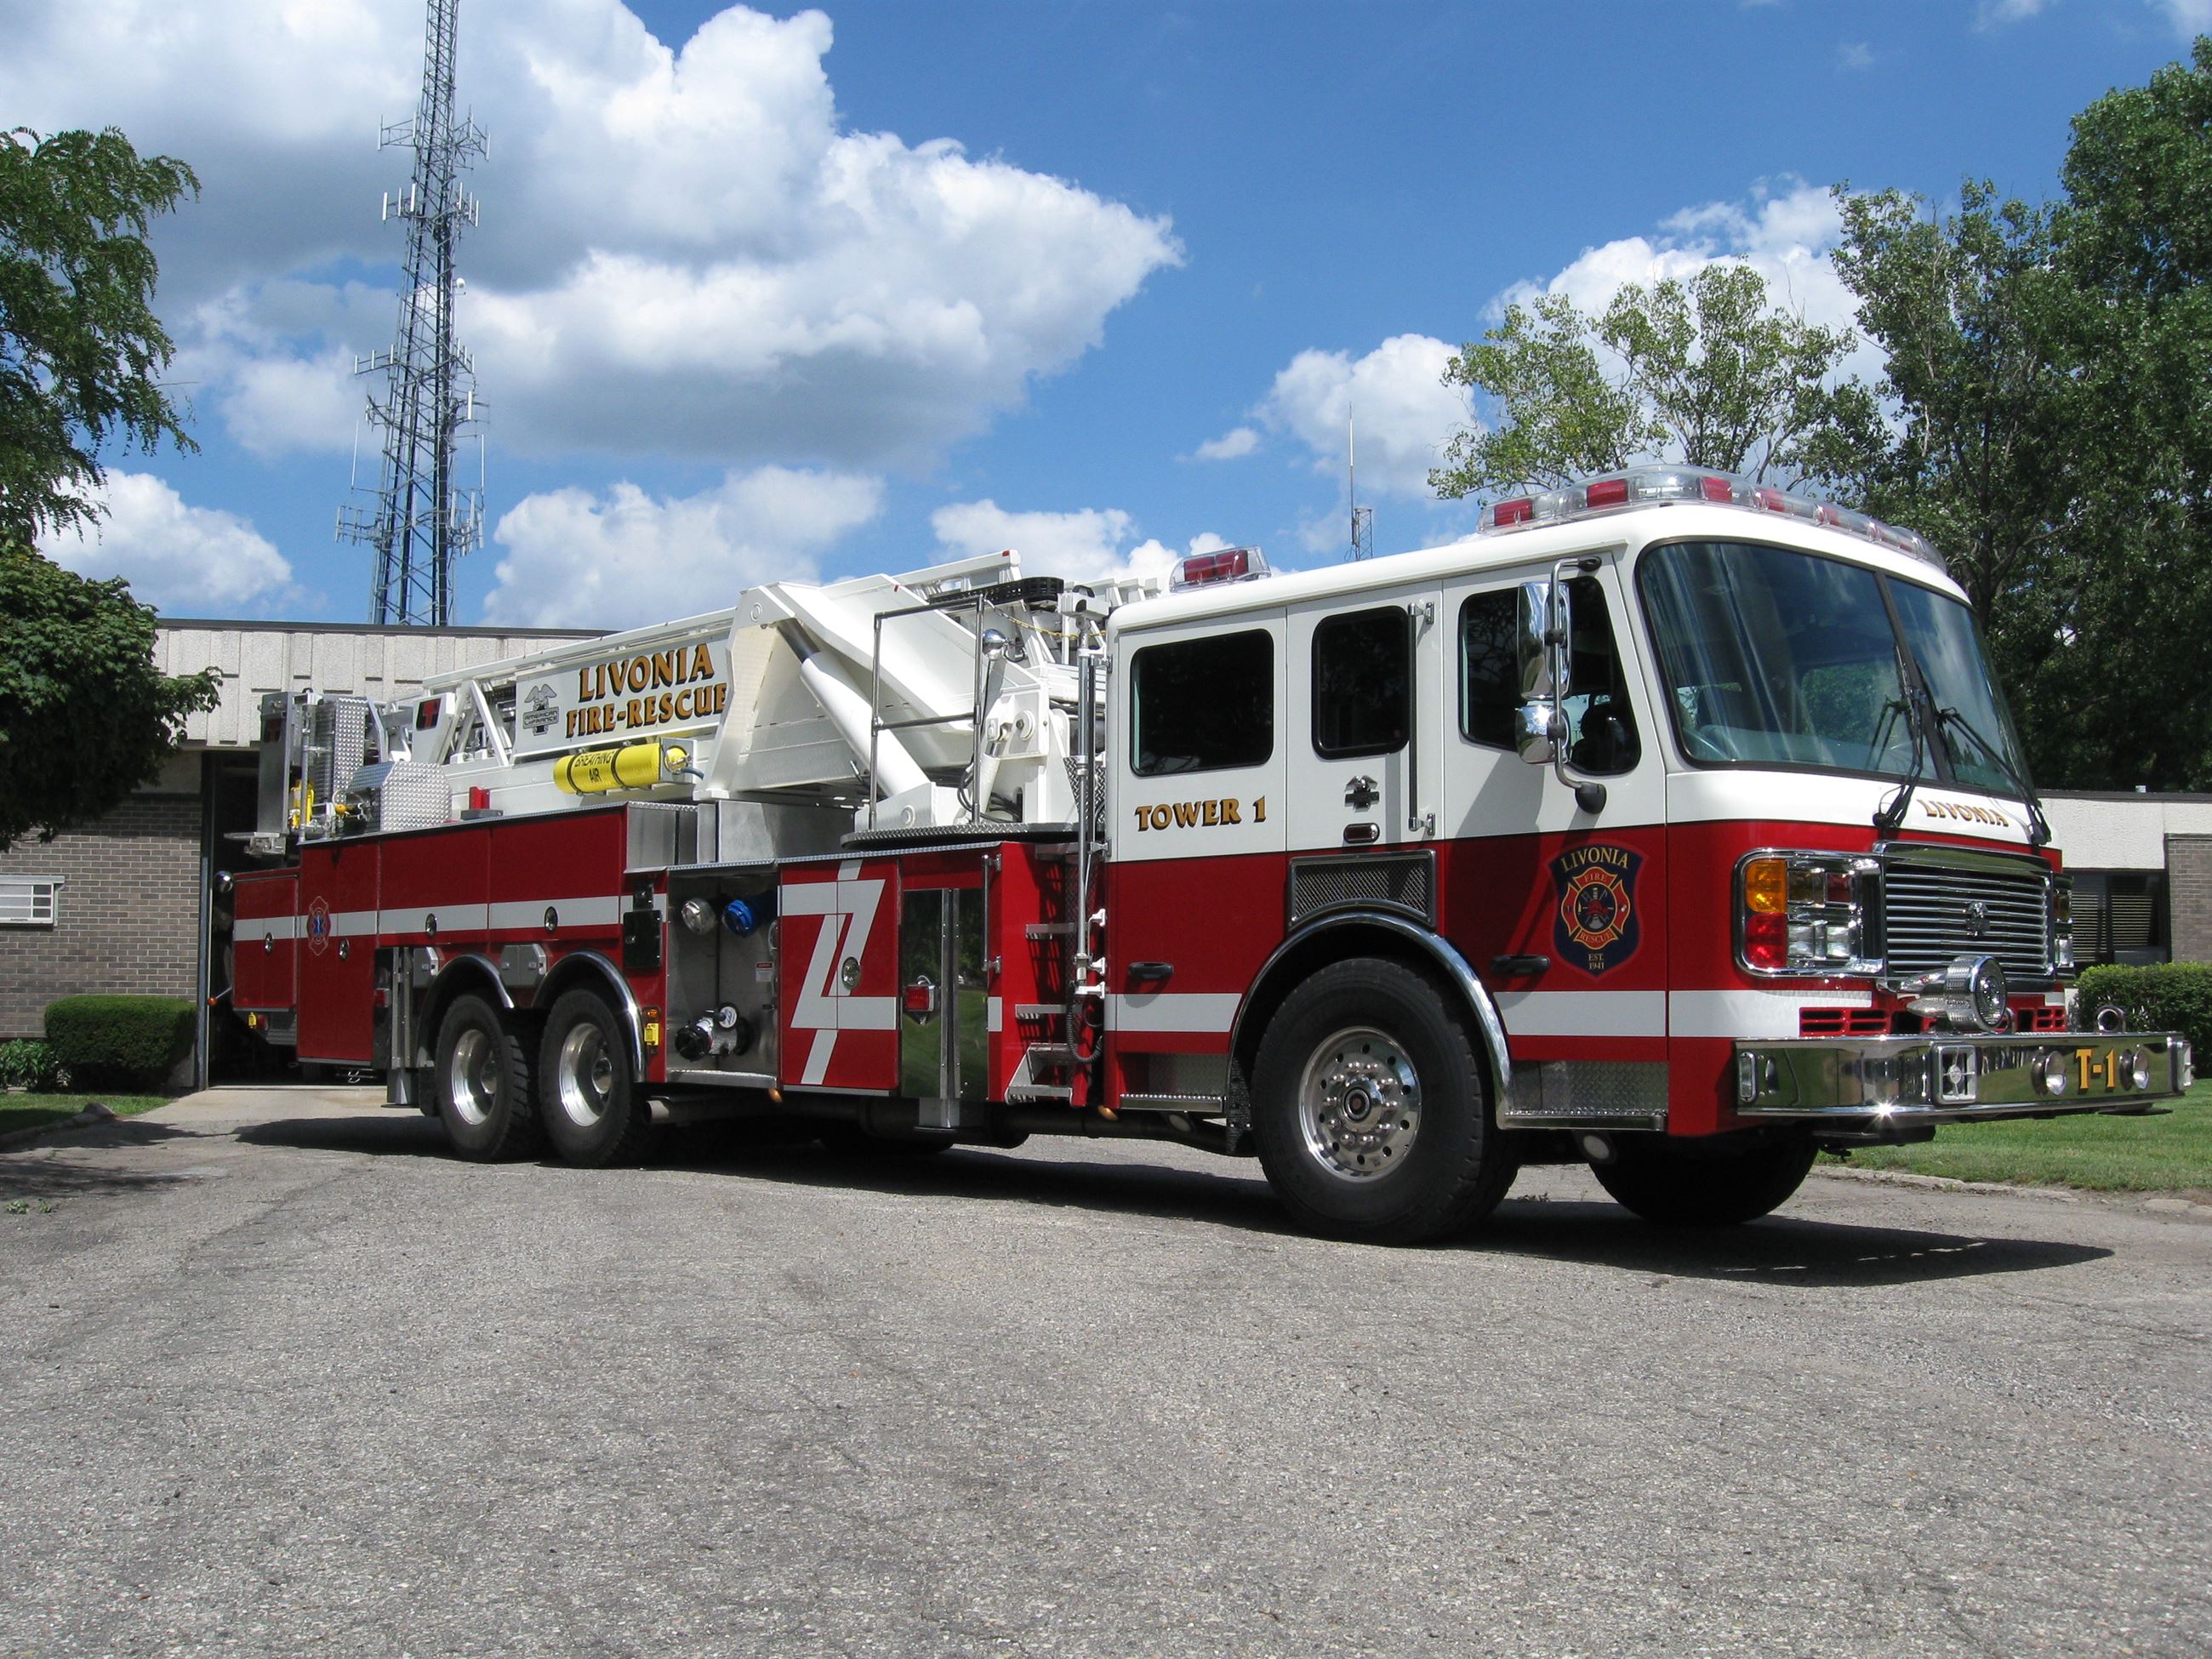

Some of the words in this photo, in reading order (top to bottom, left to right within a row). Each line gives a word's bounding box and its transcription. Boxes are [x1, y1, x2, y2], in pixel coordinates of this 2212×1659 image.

[579, 642, 715, 703] LIVONIA
[566, 683, 727, 738] FIRE-RESCUE
[589, 768, 602, 783] AIR
[1134, 798, 1242, 832] TOWER
[1252, 795, 1267, 823] 1
[1916, 799, 2009, 828] LIVONIA
[1560, 847, 1628, 872] LIVONIA
[1584, 873, 1608, 883] FIRE
[1579, 931, 1613, 943] RESCUE
[2074, 1047, 2116, 1091] T-1
